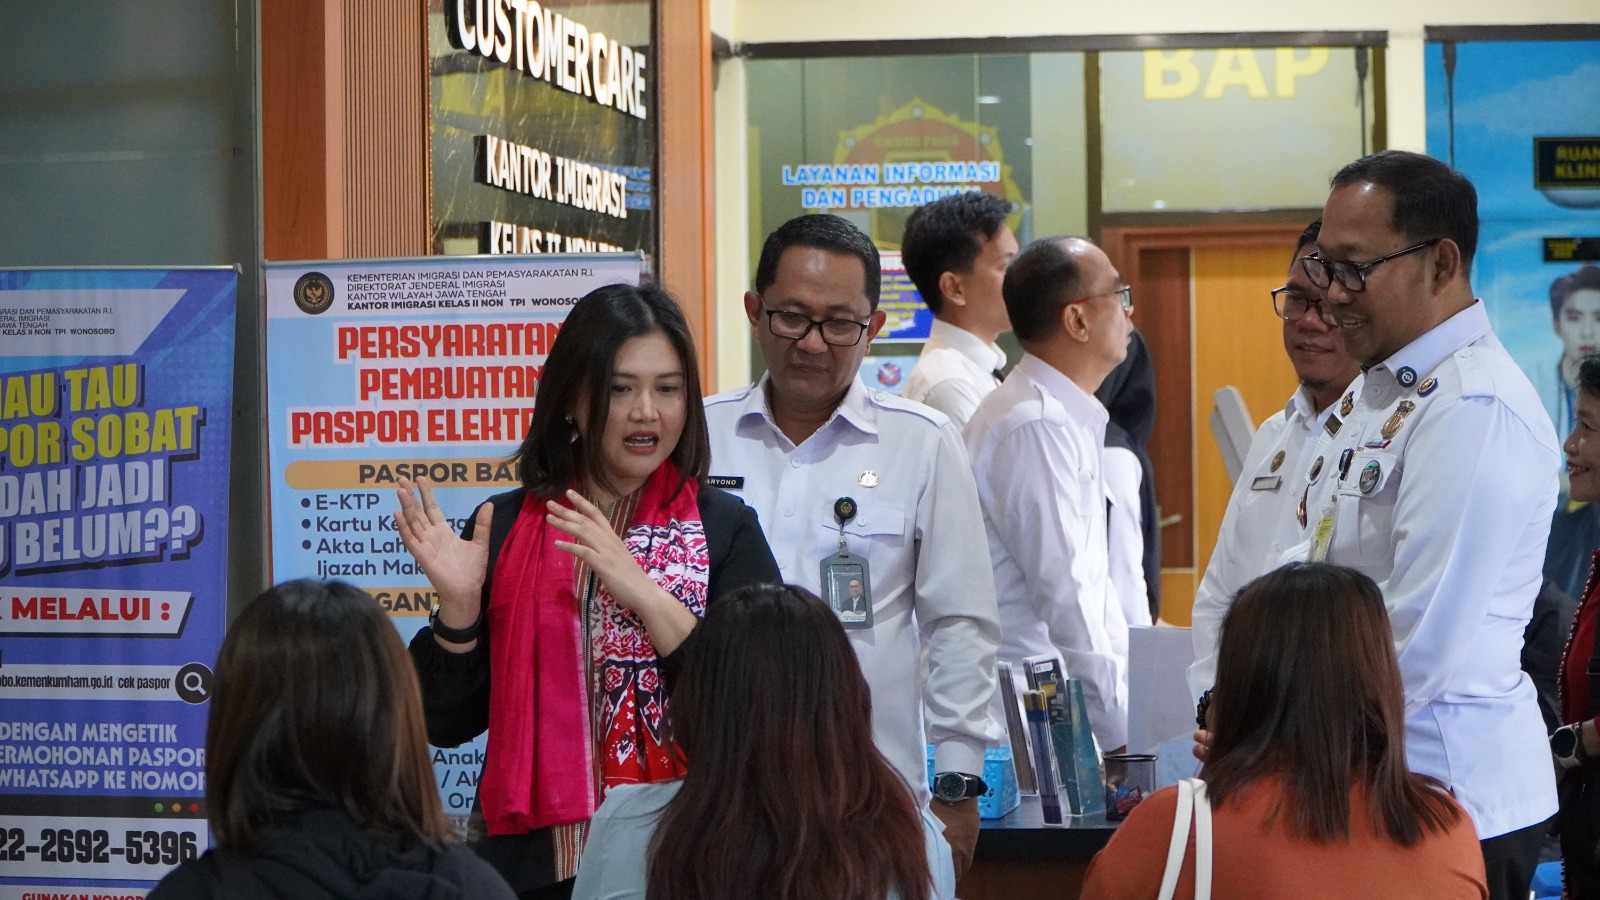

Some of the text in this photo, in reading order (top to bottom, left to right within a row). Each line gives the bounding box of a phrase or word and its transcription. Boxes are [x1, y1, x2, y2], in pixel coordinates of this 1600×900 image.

[456, 0, 647, 119] CUSTOMER CARE
[1143, 47, 1330, 99] BAP
[486, 134, 628, 219] KANTOR IMIGRASI
[783, 161, 1001, 185] LAYANAN INFORMASI
[801, 188, 848, 208] DAN
[347, 268, 595, 283] KEMENTERIAN IMIGRASI DAN PEMASYARAKATAN R.I.
[347, 280, 505, 292] DIREKTORAT JENDERAL IMIGRASI
[347, 289, 506, 301] KANTOR WILAYAH JAWA TENGAH
[347, 297, 583, 310] KANTOR IMIGRASI KELAS II NON TPI WONOSO
[0, 363, 138, 419] AU TAU
[71, 406, 199, 461] SOBAT
[292, 411, 419, 444] PASPOR
[82, 459, 164, 509] JADI
[359, 463, 468, 484] PASPOR
[316, 493, 380, 511] E-KTP
[316, 516, 372, 532] Kartu
[16, 505, 196, 565] BELUM??
[316, 538, 364, 554] Akta
[317, 559, 377, 580] Ijazah
[11, 597, 150, 621] MELALUI
[0, 675, 170, 690] bo.kemenkumham.go.id cek paspor
[0, 722, 177, 743] DENGAN MENGETIK
[104, 771, 126, 789] KE
